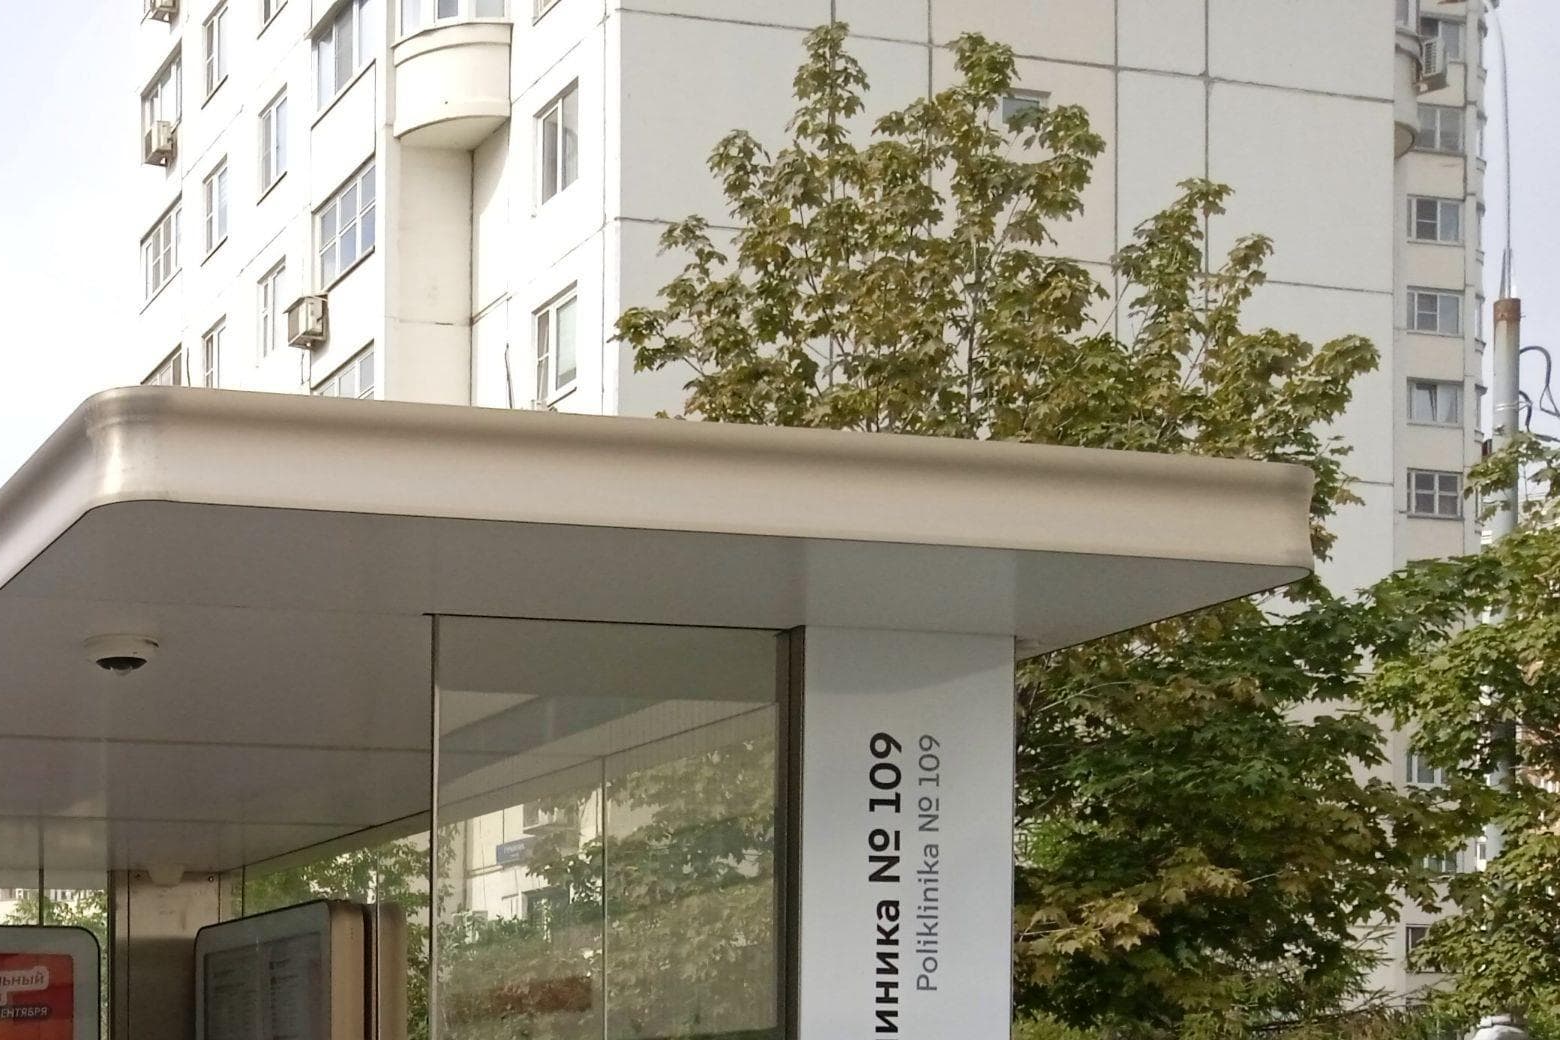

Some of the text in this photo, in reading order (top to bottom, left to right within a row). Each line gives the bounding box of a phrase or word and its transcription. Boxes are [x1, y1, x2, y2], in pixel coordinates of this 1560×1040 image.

[869, 732, 902, 813] 109
[868, 829, 901, 883] №
[916, 734, 941, 991] Poliklinika № 109
